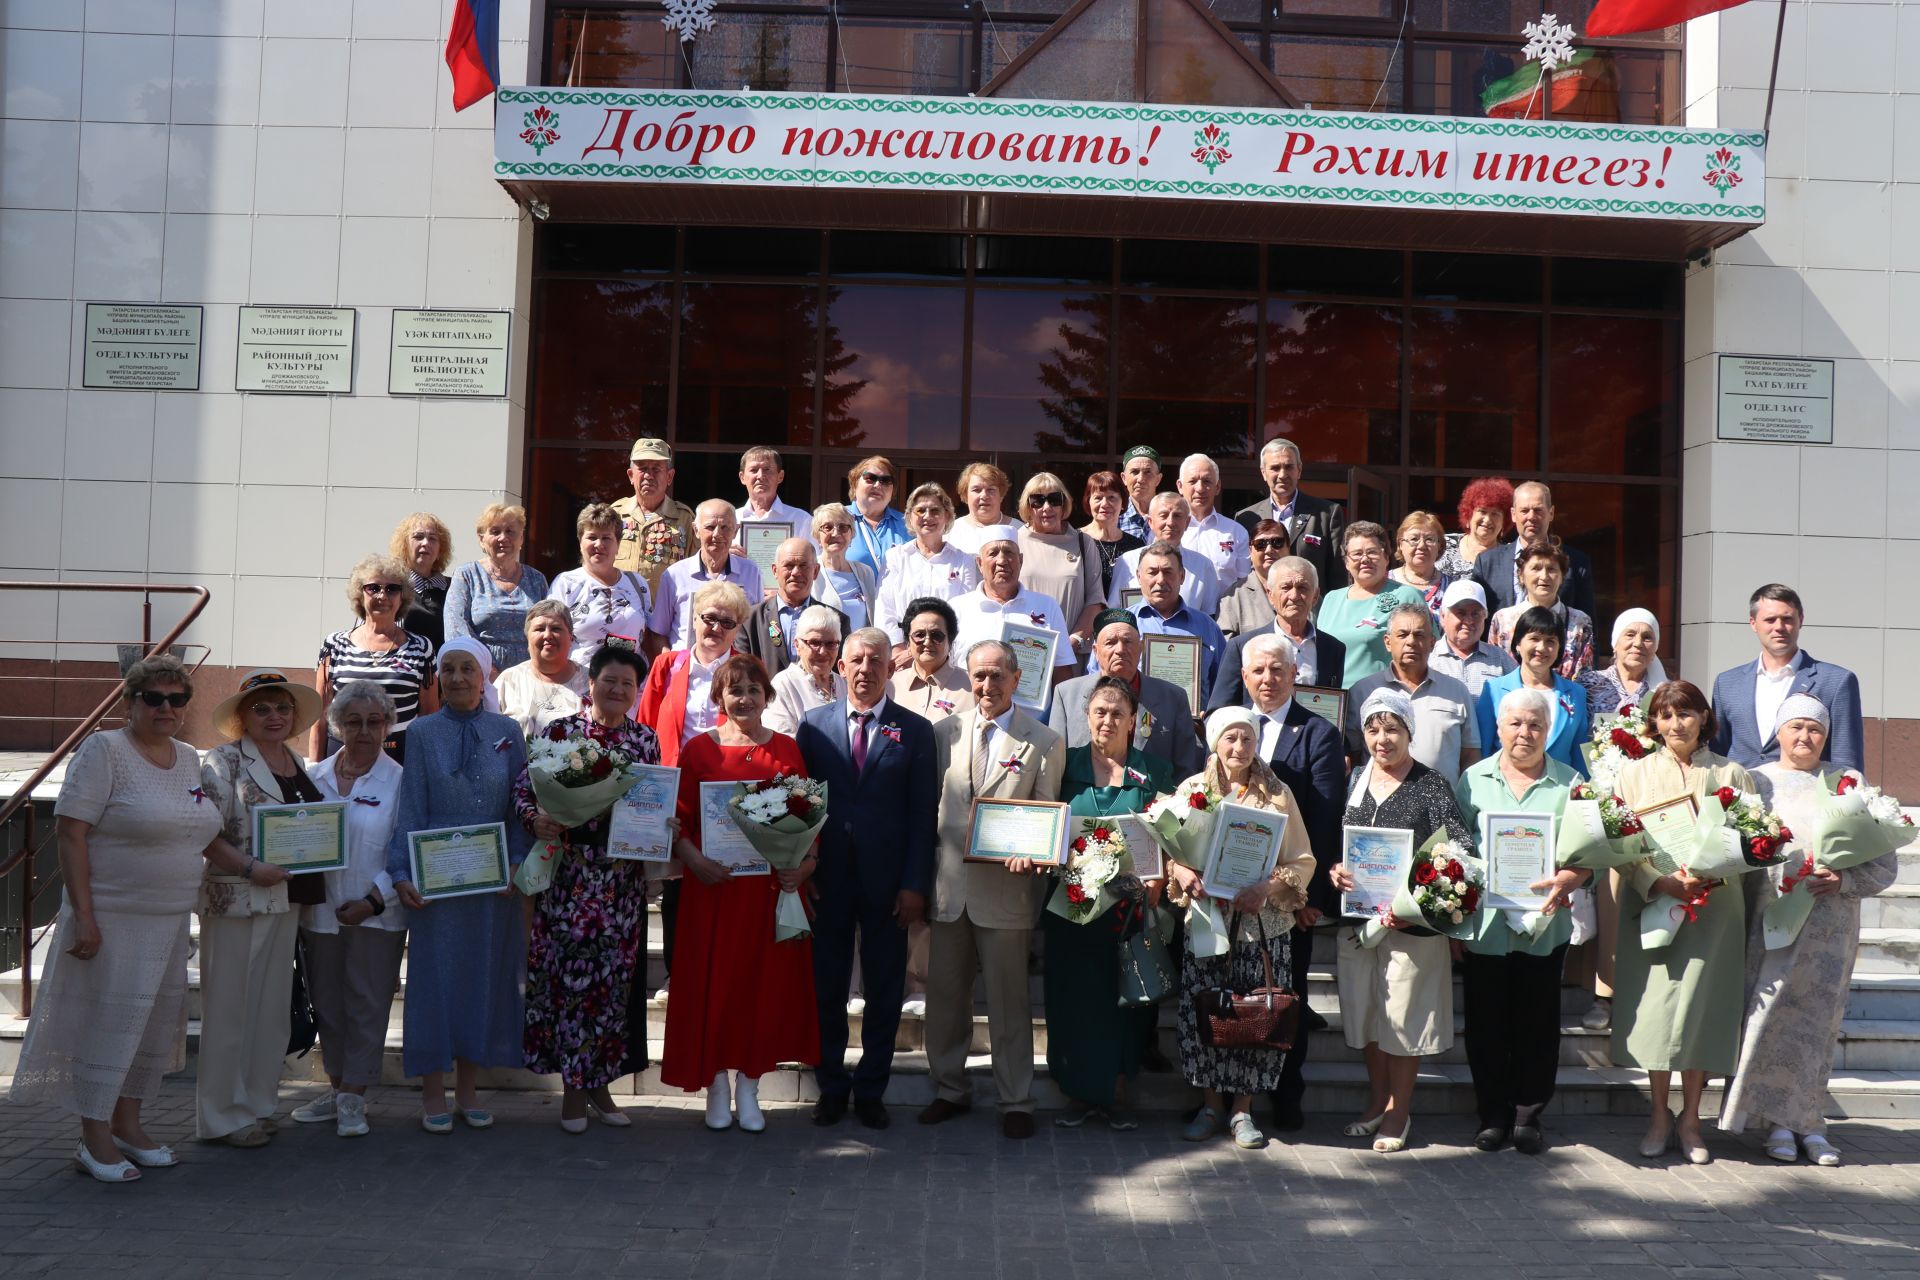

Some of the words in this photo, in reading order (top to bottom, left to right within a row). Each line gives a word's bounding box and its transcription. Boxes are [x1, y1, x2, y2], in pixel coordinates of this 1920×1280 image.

[583, 108, 756, 166] Добро
[782, 124, 1162, 167] пожаловать!
[1276, 131, 1449, 179] Рәхим
[1472, 146, 1673, 190] итегез!
[97, 328, 153, 336] МӘДӘНИЯТ
[154, 328, 191, 336] БҮЛЕГЕ
[251, 328, 306, 336] МӘДӘНИЯТ
[309, 326, 343, 336] ЙОРТЫ
[432, 332, 492, 340] КИТАПХАНӘ
[96, 350, 130, 359] ОТДЕЛ
[133, 351, 189, 360] КУЛЬТУРЫ
[252, 351, 312, 360] РАЙОННЫЙ
[411, 355, 488, 364] ЦЕНТРАЛЬНАЯ
[267, 363, 323, 371] КУЛЬТУРЫ
[413, 366, 485, 375] БИБЛИОТЕКА
[1771, 381, 1808, 390] БҮЛЕГЕ
[1744, 404, 1778, 412] ОТДЕЛ
[1781, 404, 1807, 413] ЗАГС
[628, 800, 663, 810] ДИПЛОМ
